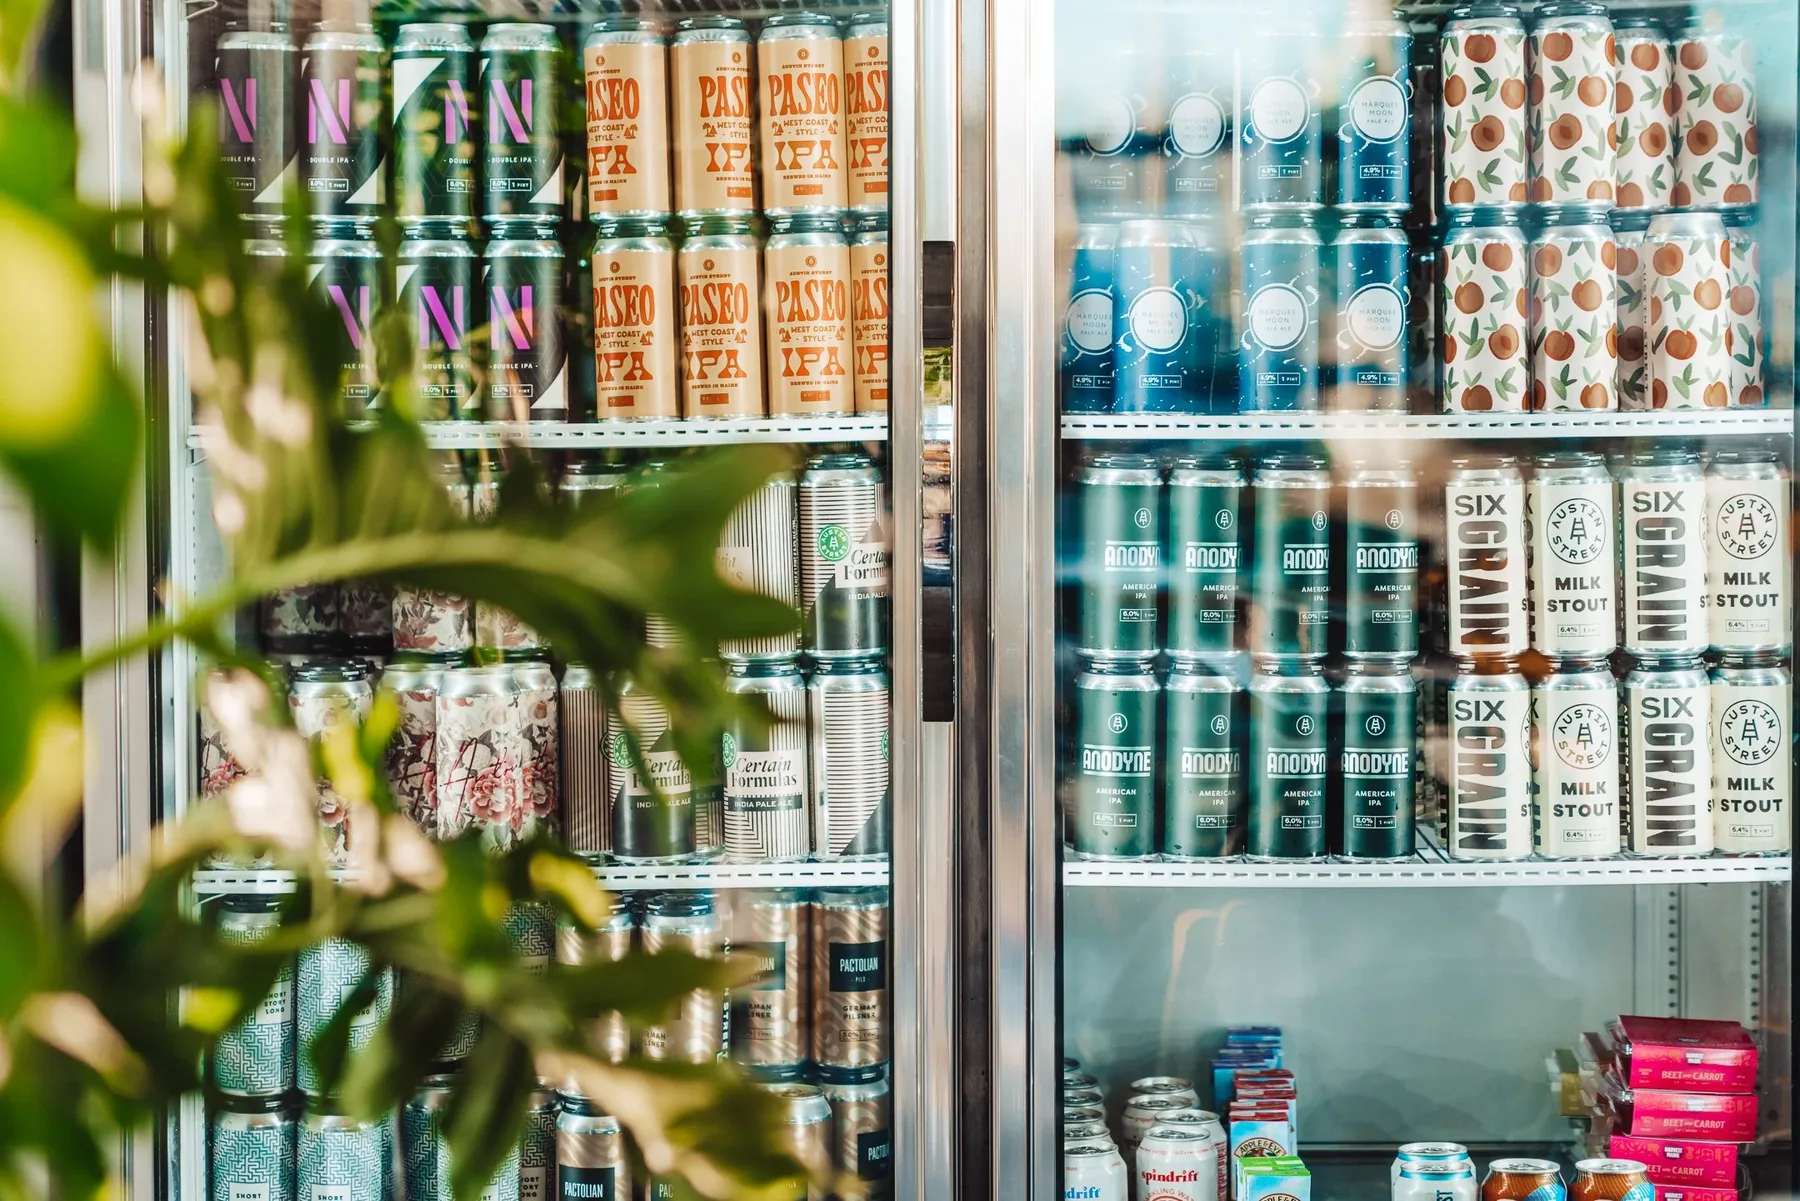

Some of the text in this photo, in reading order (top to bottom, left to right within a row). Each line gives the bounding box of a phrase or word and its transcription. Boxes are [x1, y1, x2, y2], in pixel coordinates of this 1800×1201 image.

[585, 77, 640, 122] ASEO
[768, 73, 839, 117] PASEO
[308, 79, 350, 144] N
[489, 79, 532, 144] N
[595, 134, 613, 142] STYLE
[796, 128, 818, 136] STYLE
[774, 140, 838, 171] IPA
[593, 284, 655, 328] PASEO
[681, 282, 749, 327] PASEO
[776, 279, 846, 323] PASEO
[852, 277, 888, 321] PAS
[419, 285, 464, 350] N
[490, 285, 533, 350] N
[609, 340, 629, 348] STYLE
[701, 337, 724, 345] STYLE
[596, 351, 653, 383] IPA
[685, 349, 747, 380] IPA
[781, 347, 845, 377] IPA
[857, 344, 888, 375] IP
[1454, 494, 1507, 517] SIX
[1632, 490, 1686, 513] SIX
[1721, 499, 1773, 524] AUSTIN
[1552, 502, 1603, 530] AUSTIN
[1552, 536, 1603, 560] STREET
[1721, 530, 1773, 555] STREET
[1104, 546, 1160, 567] ANODYN
[1185, 546, 1243, 568] ANODYN
[1283, 549, 1329, 570] ANODY
[1356, 547, 1418, 568] ANODYNE
[1458, 520, 1510, 645] GRAIN
[1555, 576, 1602, 591] MILK
[1635, 517, 1687, 642] GRAIN
[1723, 572, 1771, 586] MILK
[1547, 598, 1607, 613] STOUT
[1716, 593, 1779, 608] STOUT
[1560, 626, 1578, 634] 6.4%
[1454, 699, 1506, 721] SIX
[1641, 696, 1693, 719] SIX
[1727, 704, 1776, 730] AUSTIN
[1558, 708, 1608, 734] AUSTIN
[1558, 740, 1608, 765] STREET
[1726, 736, 1777, 761] STREET
[736, 757, 791, 772] Certain
[1083, 749, 1151, 771] ANODYNE
[1182, 752, 1240, 773] ANODYN
[1267, 752, 1326, 773] ANODYN
[1341, 752, 1408, 774] ANODYNE
[731, 772, 797, 788] Formulas
[1457, 725, 1507, 850] GRAIN
[1561, 781, 1607, 795] MILK
[1644, 722, 1696, 847] GRAIN
[1727, 777, 1775, 791] MILK
[1553, 802, 1613, 818] STOUT
[1720, 798, 1783, 813] STOUT
[839, 957, 878, 973] PACTOLIAN
[843, 1004, 877, 1012] GERMAN
[1662, 1071, 1682, 1079] BEET
[1693, 1072, 1725, 1081] CARROT
[1663, 1118, 1684, 1127] BEET
[1693, 1119, 1725, 1129] CARROT
[1239, 1140, 1262, 1155] APPLE
[1269, 1142, 1283, 1155] EVE
[1141, 1168, 1199, 1185] spindrift
[1647, 1165, 1662, 1173] EET
[1672, 1167, 1704, 1176] CARROT
[564, 1182, 603, 1198] PACTOLIAN
